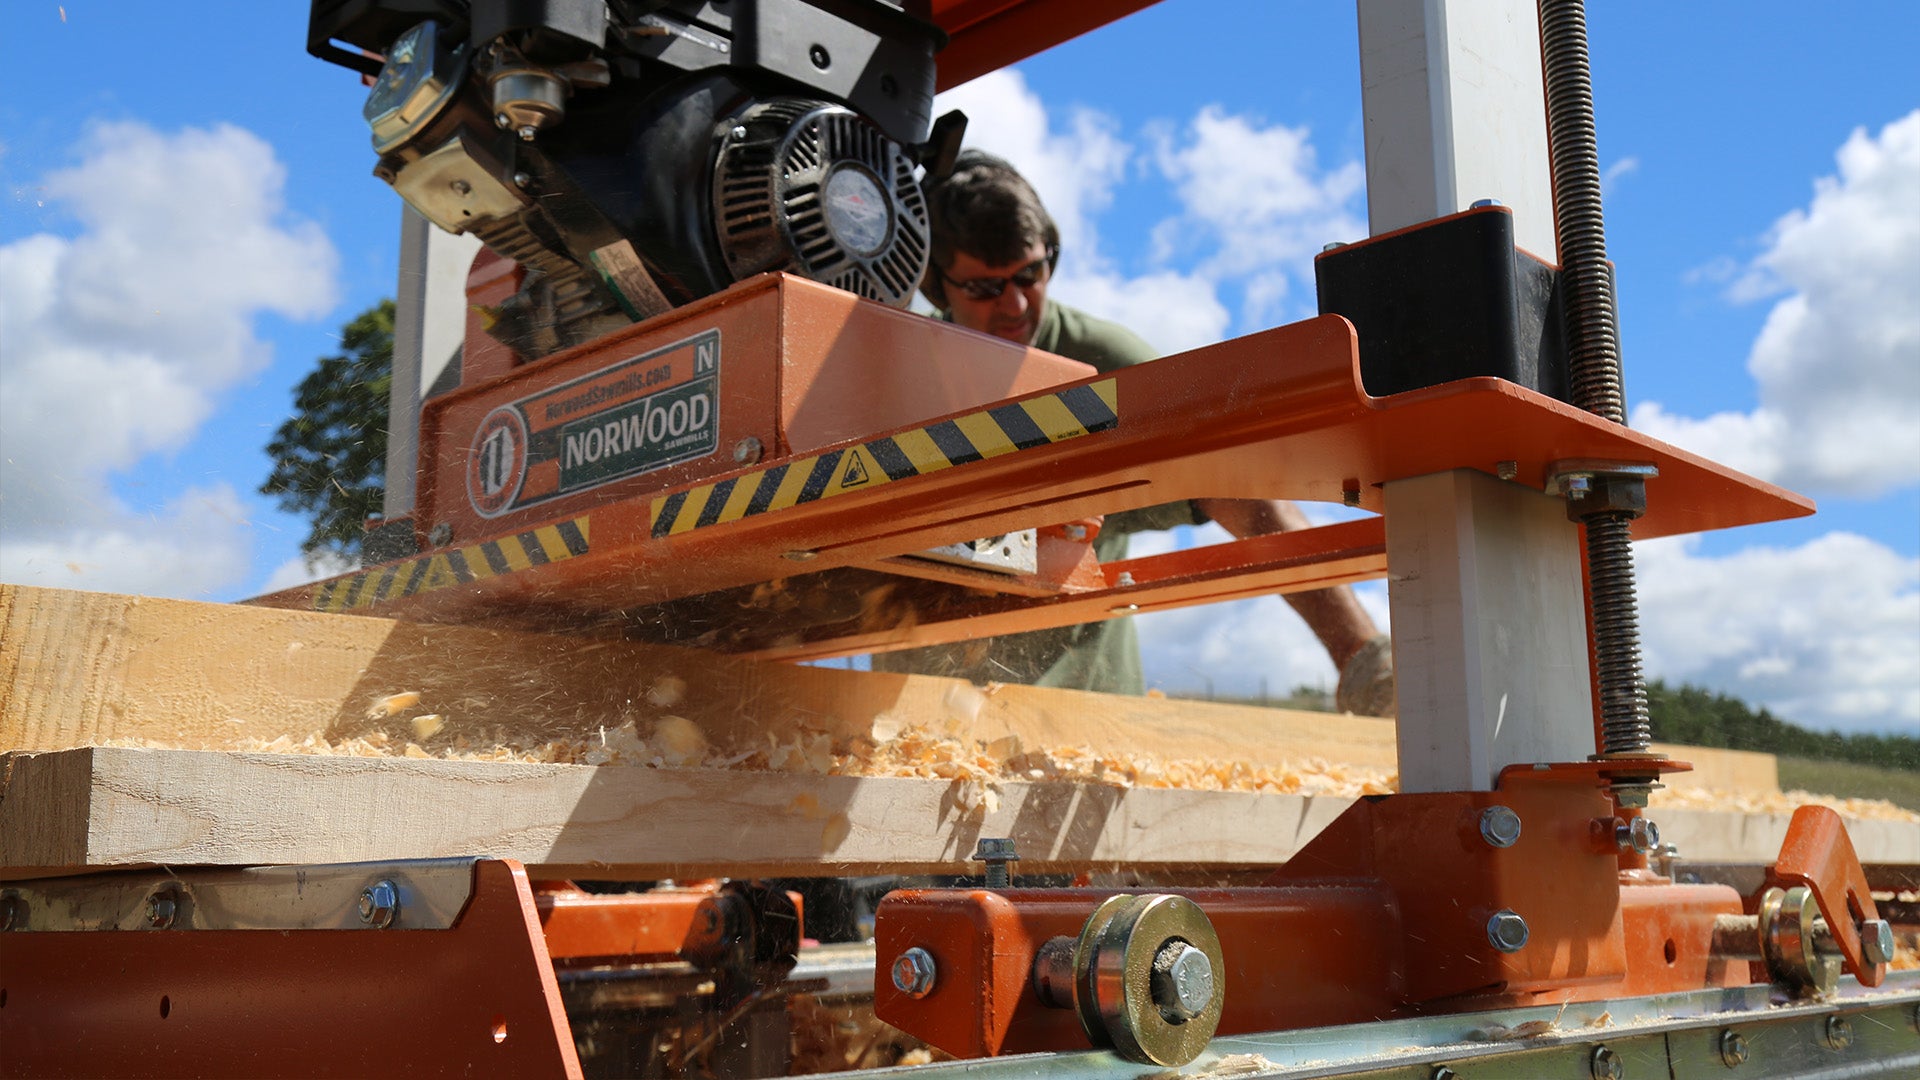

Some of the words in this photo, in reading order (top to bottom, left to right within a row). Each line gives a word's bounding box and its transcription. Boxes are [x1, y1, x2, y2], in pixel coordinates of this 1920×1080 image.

[697, 341, 714, 374] N
[545, 364, 672, 422] NorwoodSawmills.com
[566, 393, 710, 470] NORWOOD
[664, 429, 709, 451] SAWMILLS
